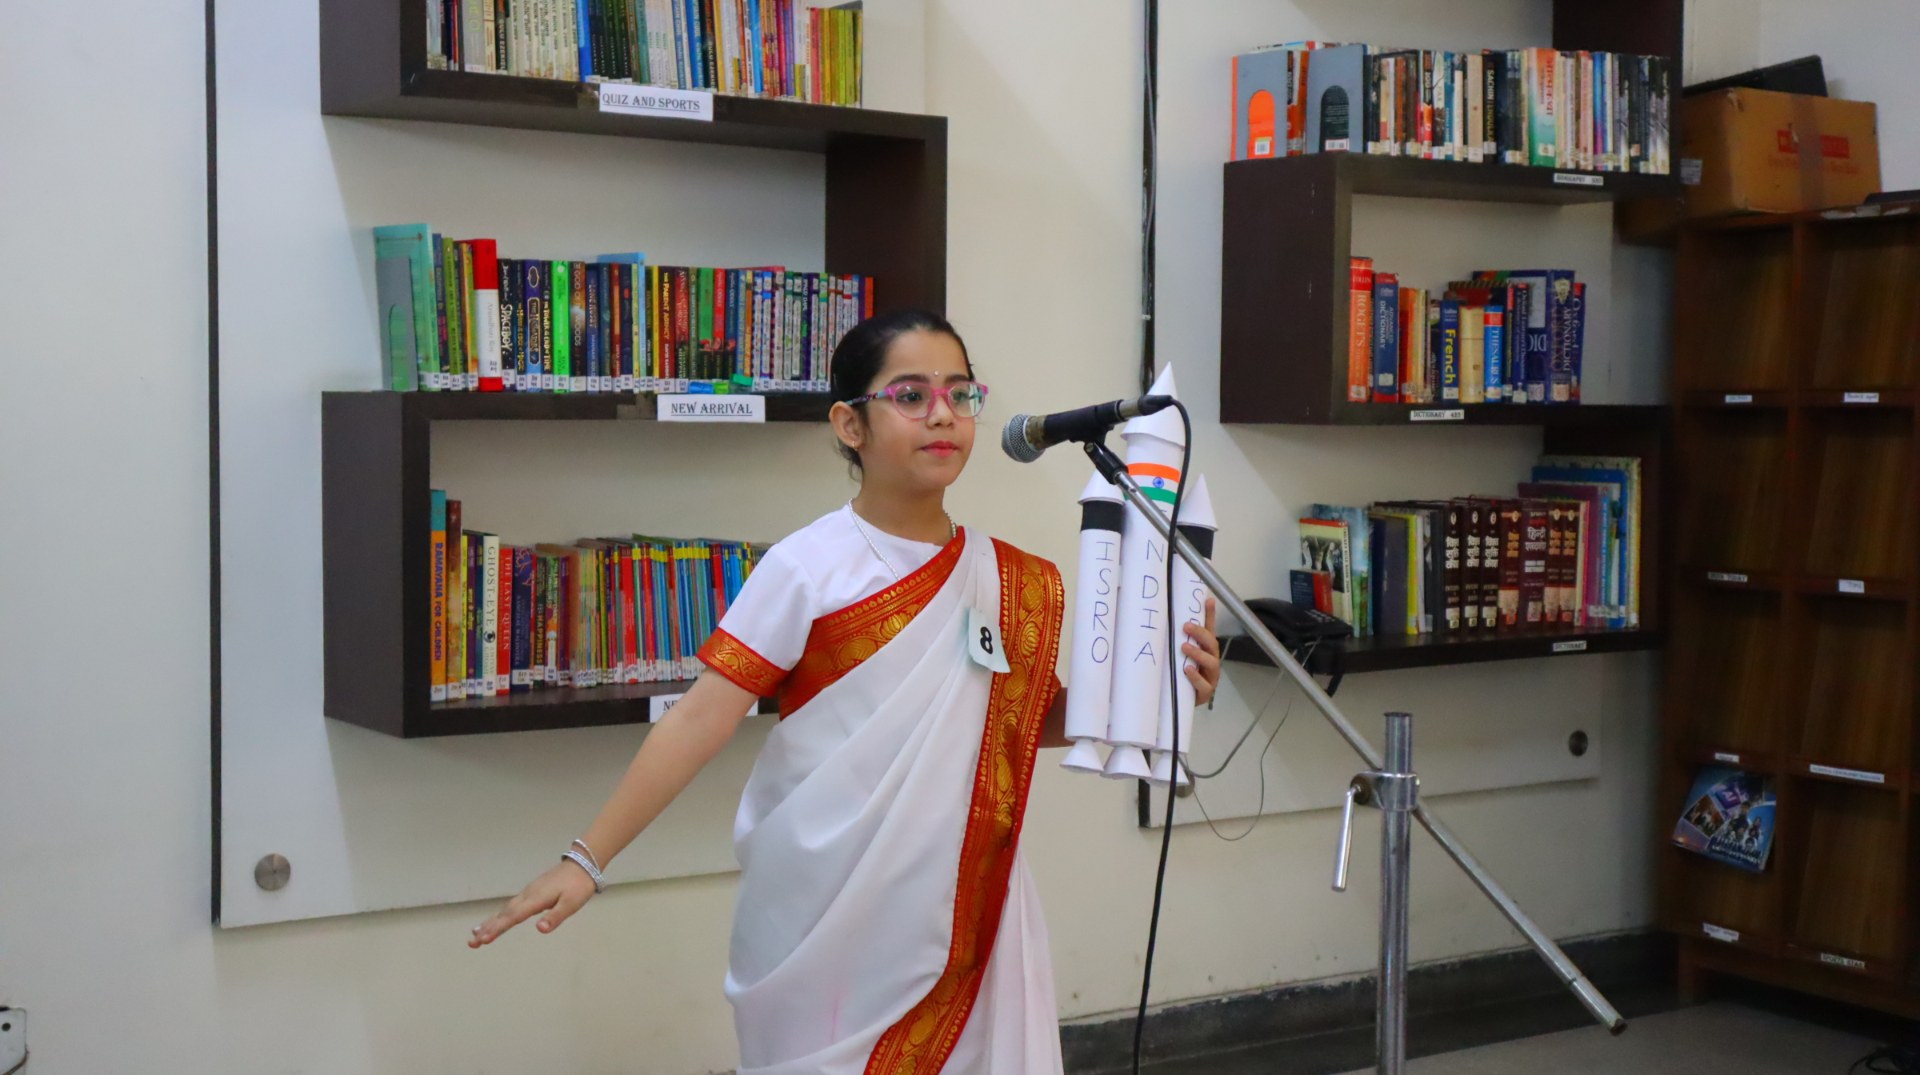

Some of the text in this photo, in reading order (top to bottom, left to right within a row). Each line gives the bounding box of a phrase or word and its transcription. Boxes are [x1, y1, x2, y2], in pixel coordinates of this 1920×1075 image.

[602, 93, 700, 111] QUIZ AND SPORTS
[501, 304, 513, 351] SPACEBOY
[1356, 294, 1367, 347] ROGET'S
[1563, 307, 1571, 371] DICTIONARY
[1572, 298, 1581, 348] Oxford
[1445, 329, 1456, 384] French
[1491, 329, 1499, 384] THESAURUS
[671, 402, 753, 414] NEW ARRIVAL
[434, 542, 444, 598] RAMAYANA
[486, 546, 496, 627] GHOST-EYE
[1134, 509, 1165, 666] NDIA
[1092, 541, 1115, 664] ISRO
[434, 620, 442, 661] CHILDREN
[502, 613, 510, 650] QUEEN
[980, 626, 994, 655] 8
